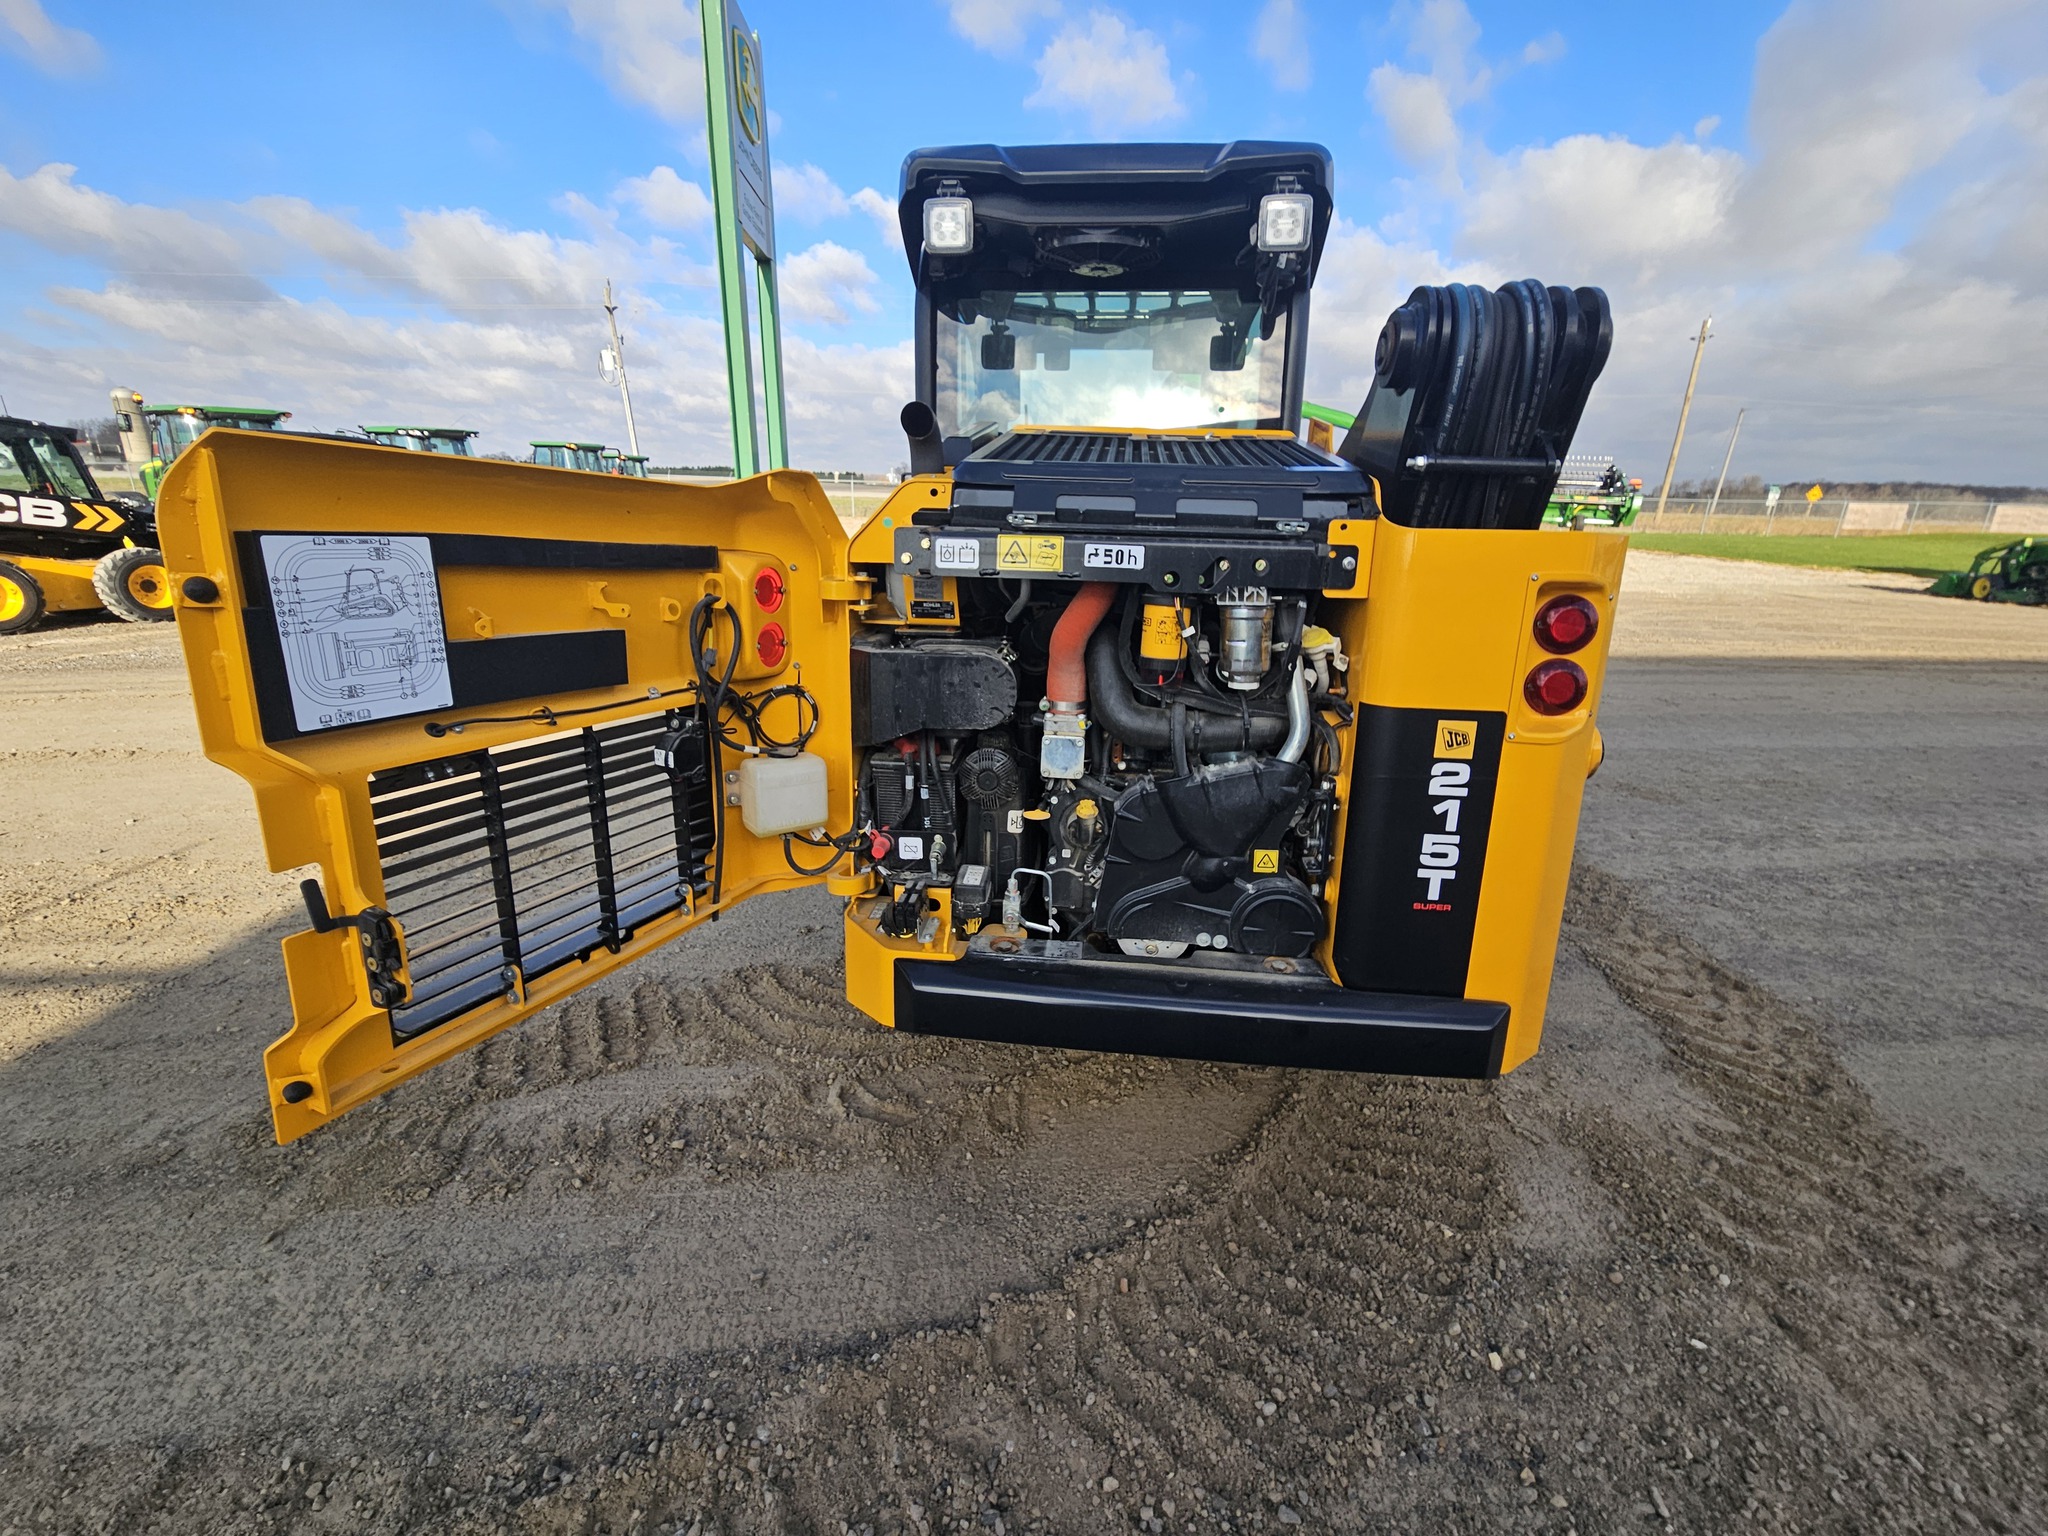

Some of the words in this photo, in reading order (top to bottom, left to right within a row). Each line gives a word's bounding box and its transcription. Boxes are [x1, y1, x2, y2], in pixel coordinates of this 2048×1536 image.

[1103, 548, 1125, 566] 50
[1127, 549, 1138, 566] h
[1446, 731, 1470, 748] JCB
[1417, 762, 1472, 901] 215T
[1413, 903, 1452, 912] SUPER
